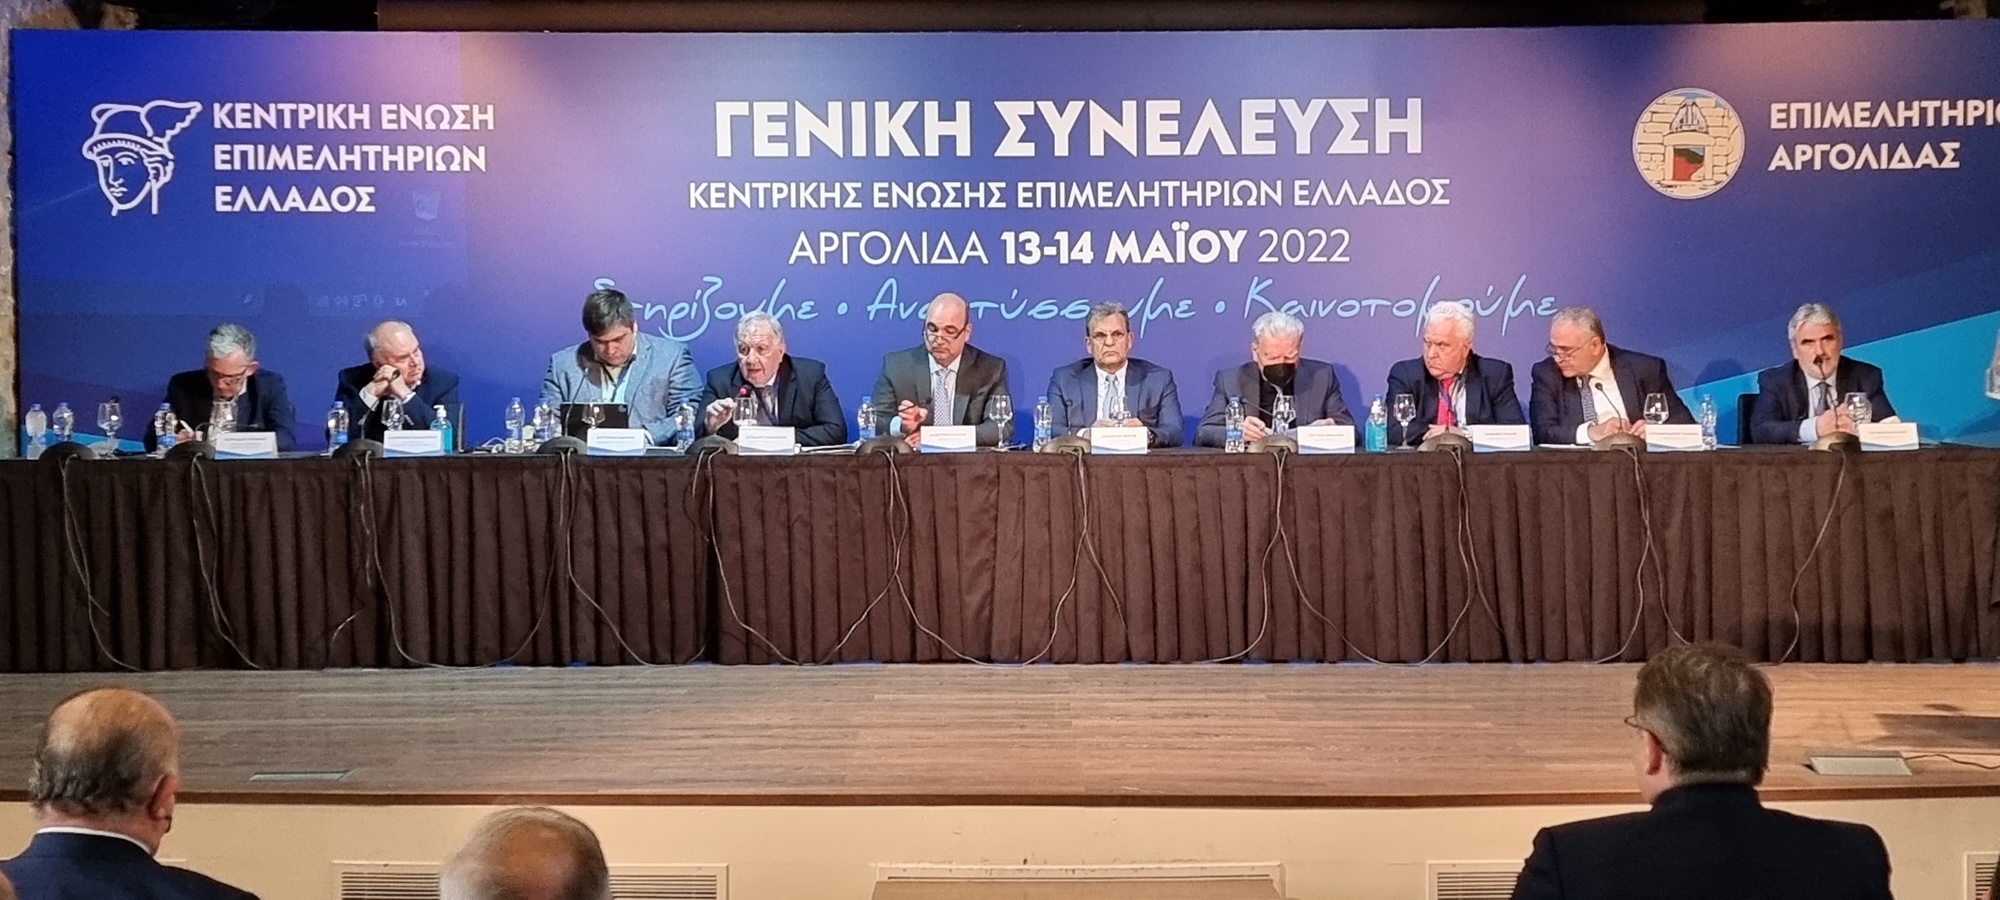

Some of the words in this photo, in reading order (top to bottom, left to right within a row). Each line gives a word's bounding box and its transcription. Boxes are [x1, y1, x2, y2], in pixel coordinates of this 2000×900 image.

[213, 103, 370, 130] ΚΕΝΤΡΙΚΗ
[381, 103, 494, 130] ΕΝΩΣΗ
[715, 100, 971, 158] ΓΕΝΙΚΗ
[994, 98, 1423, 158] ΣΥΝΕΛΕΥΣΗ
[1770, 99, 2000, 129] ΕΠΙΜΕΛΗΤΗΡΙ
[214, 144, 486, 172] ΕΠΙΜΕΛΗΤΗΡΙΩΝ
[1767, 142, 1961, 172] ΑΡΓΟΛΙΔΑΣ
[214, 185, 376, 213] ΕΛΛΑΔΟΣ
[689, 182, 863, 209] ΚΕΝΤΡΙΚΗΣ
[873, 182, 1007, 209] ΕΝΩΣΗΣ
[1017, 180, 1283, 208] ΕΠΙΜΕΛΗΤΗΡΙΩΝ
[1294, 178, 1451, 206] ΕΛΛΑΔΟΣ
[788, 230, 989, 265] ΑΡΓΟΛΙΔΑ
[1000, 230, 1094, 265] 13-14
[1105, 221, 1248, 265] ΜΑΪΟΥ
[1258, 228, 1351, 263] 2022
